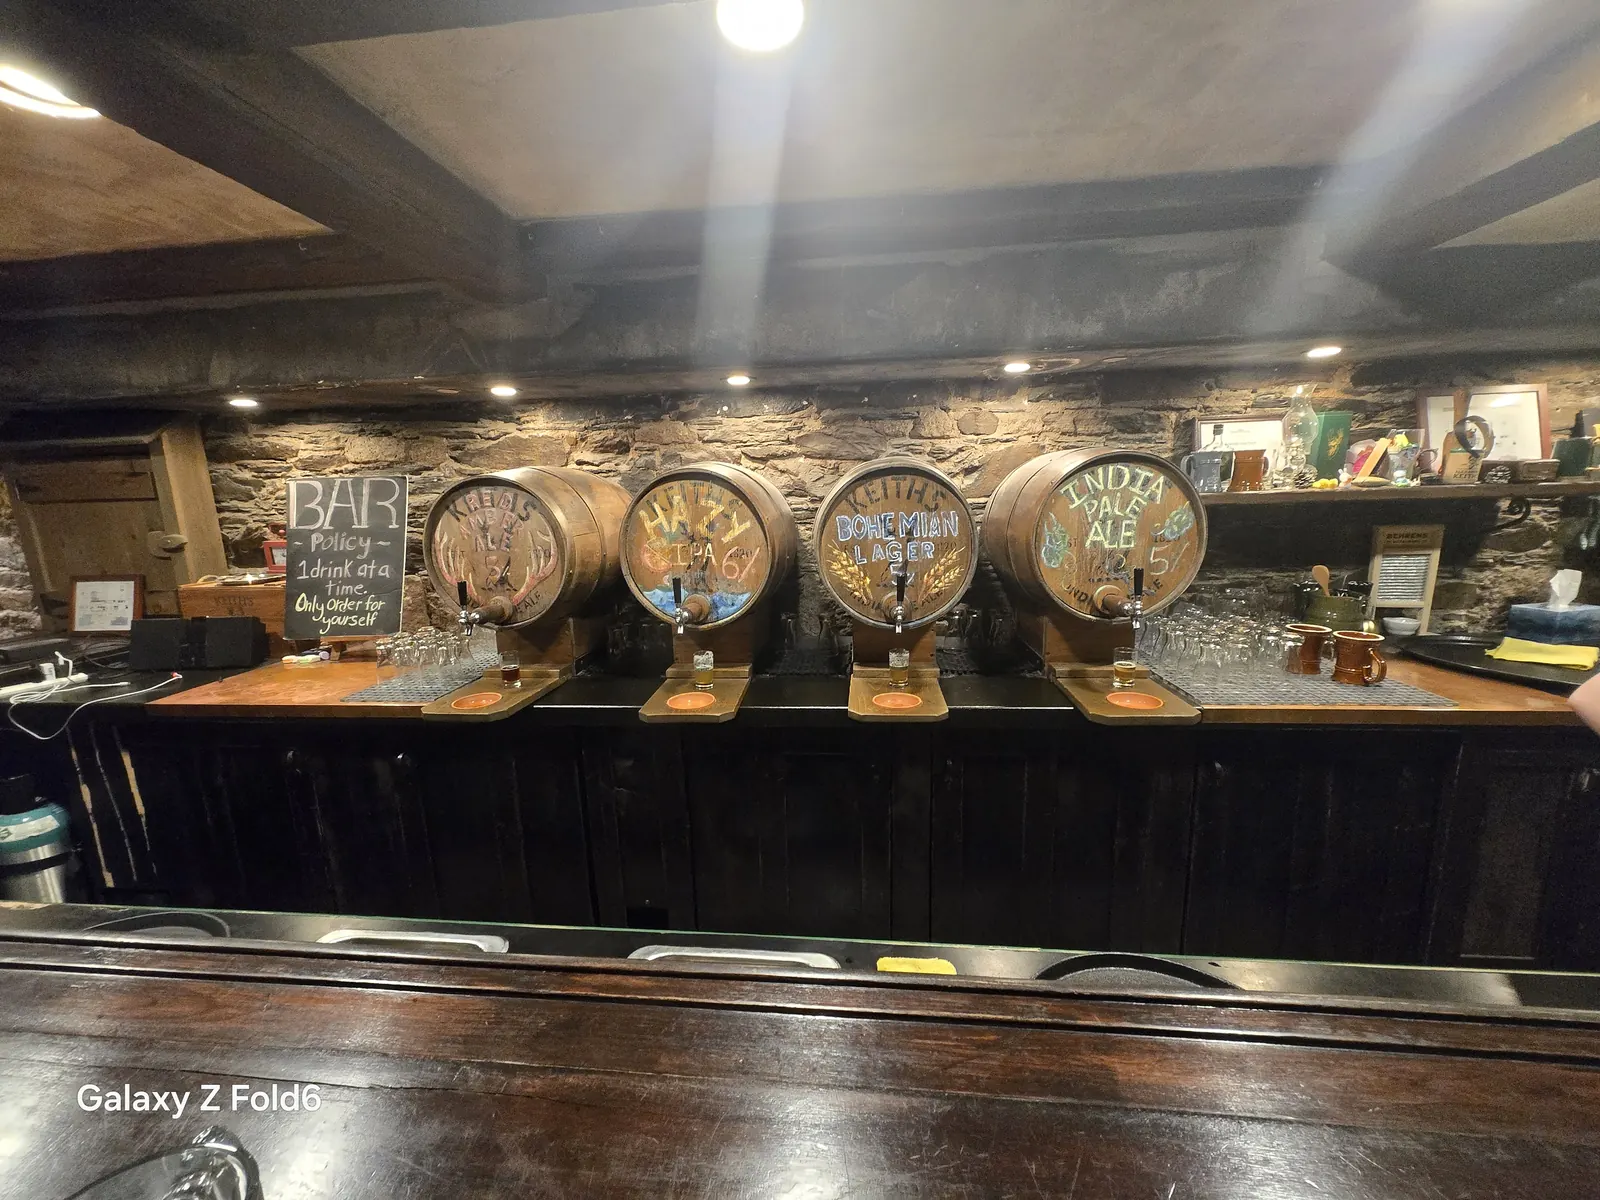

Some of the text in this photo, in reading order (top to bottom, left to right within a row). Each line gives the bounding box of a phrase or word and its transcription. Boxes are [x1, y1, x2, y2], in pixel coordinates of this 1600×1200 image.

[1060, 465, 1165, 509] INDIA
[286, 477, 400, 530] BAR
[1084, 492, 1148, 522] PALE
[639, 495, 751, 544] HAZY
[836, 511, 959, 541] BOHEMIAN
[1084, 519, 1138, 549] ALE
[310, 531, 372, 560] Policy
[672, 542, 718, 568] IPA
[854, 541, 935, 565] LAGER
[295, 592, 325, 622] Only
[365, 594, 386, 611] for
[319, 611, 379, 635] yourself
